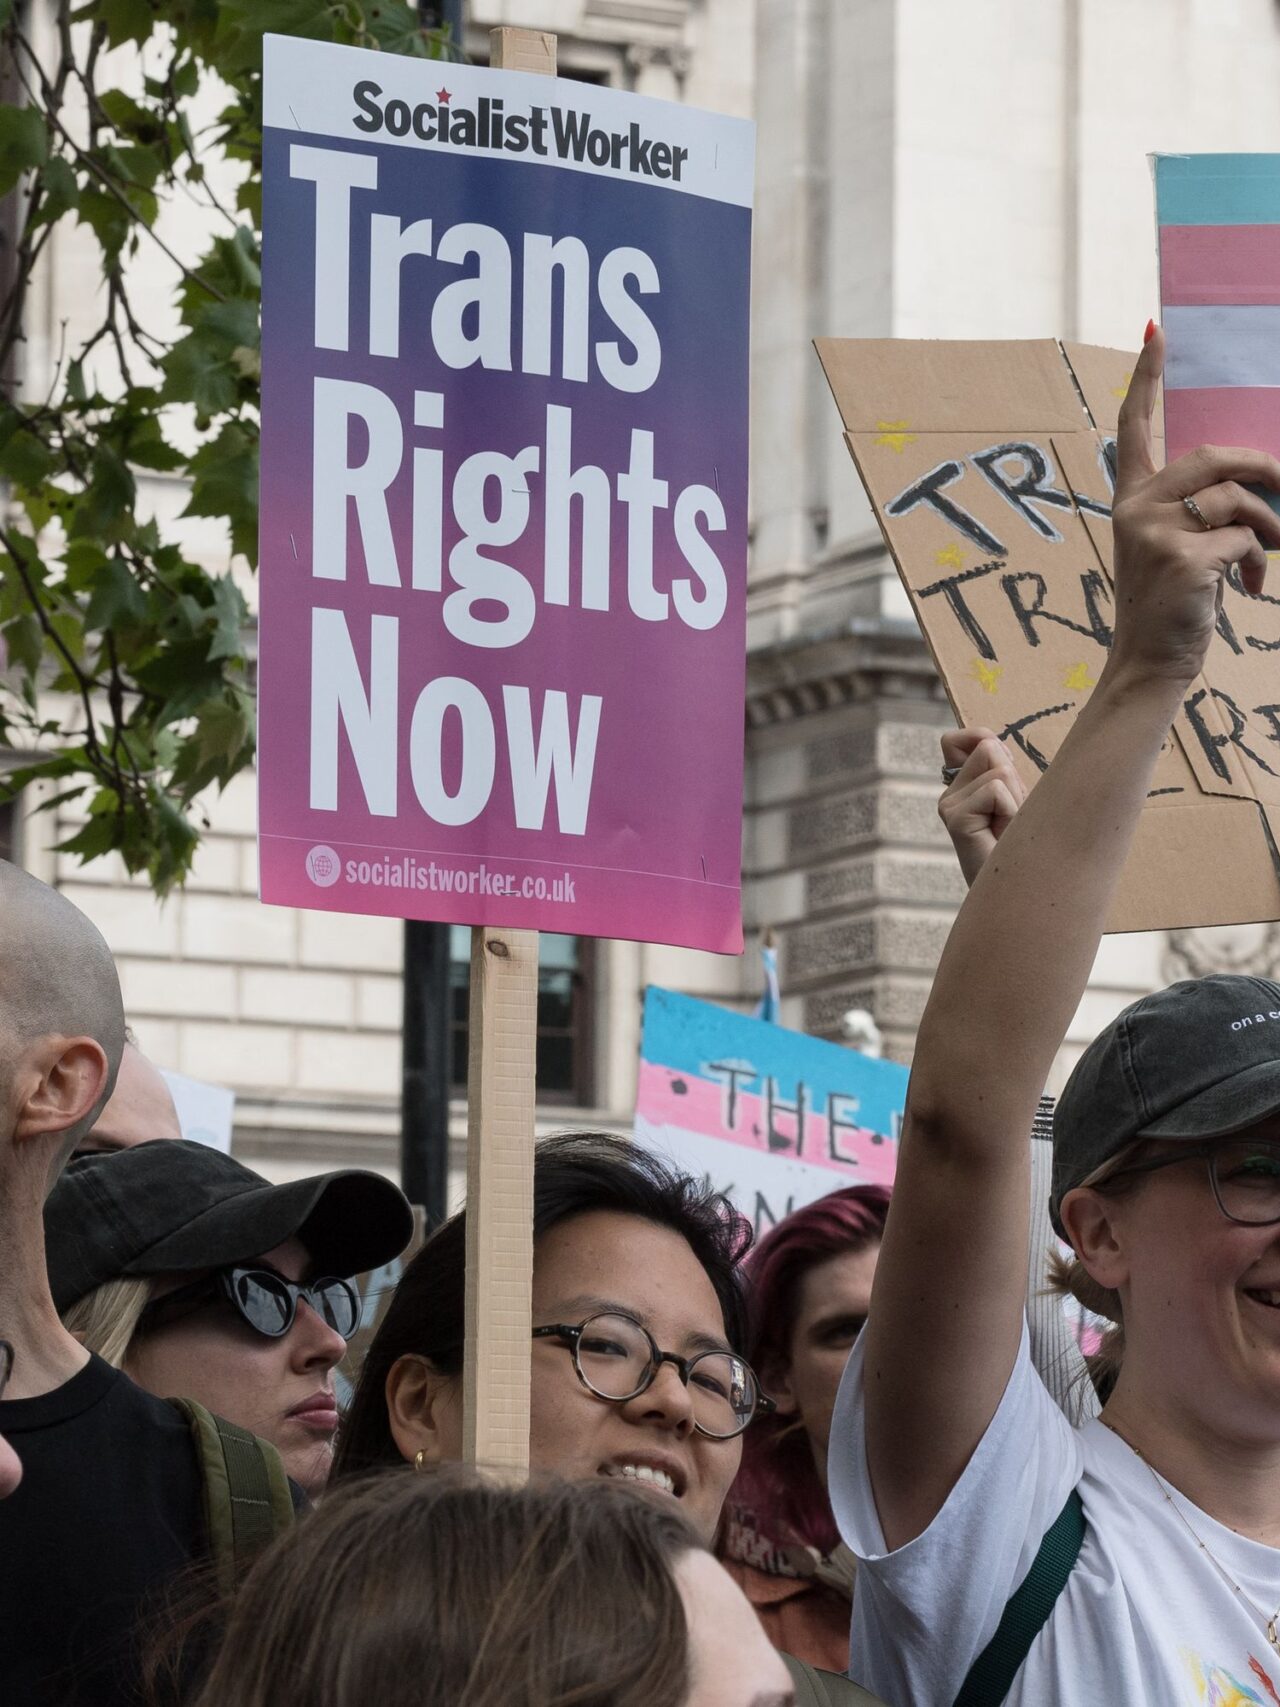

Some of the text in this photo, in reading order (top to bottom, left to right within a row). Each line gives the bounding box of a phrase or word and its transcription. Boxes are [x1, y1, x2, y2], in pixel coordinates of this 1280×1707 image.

[289, 143, 662, 394] Trans
[311, 376, 728, 649] Rights
[309, 606, 604, 837] Now
[346, 856, 576, 903] socialistworker.co.uk
[1231, 1016, 1252, 1031] on
[1255, 1014, 1266, 1023] a
[708, 1062, 861, 1166] THE
